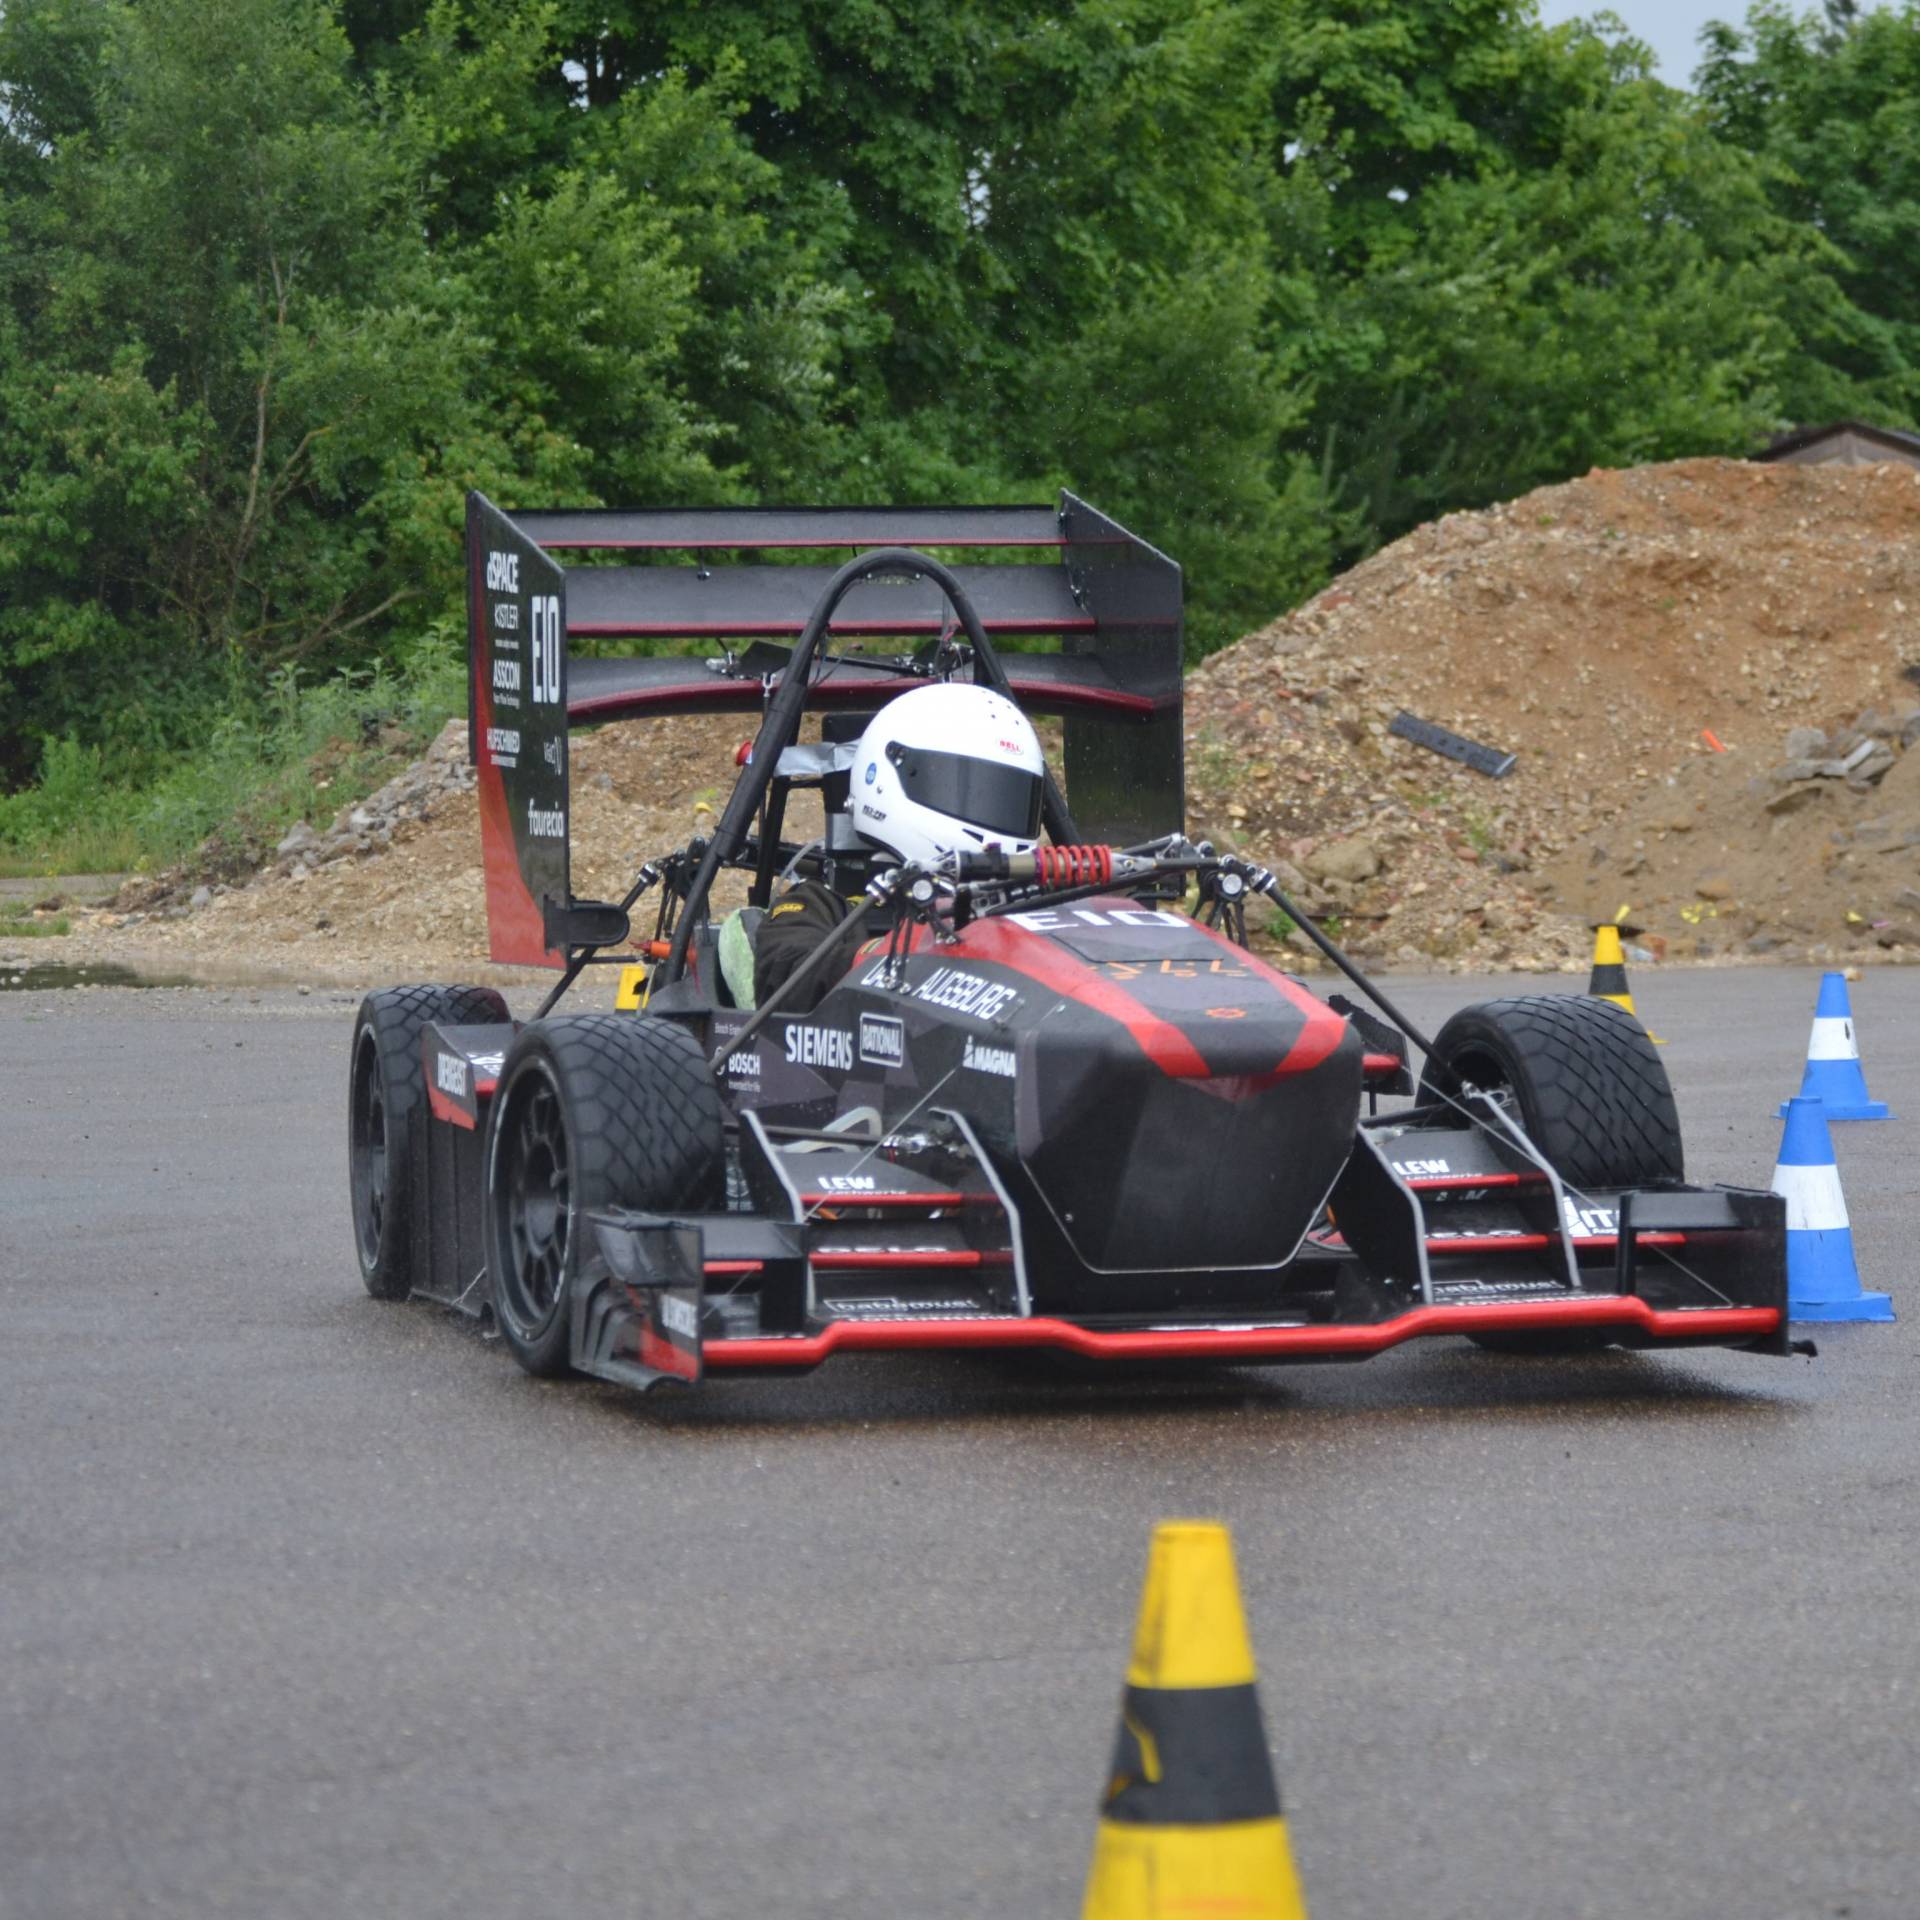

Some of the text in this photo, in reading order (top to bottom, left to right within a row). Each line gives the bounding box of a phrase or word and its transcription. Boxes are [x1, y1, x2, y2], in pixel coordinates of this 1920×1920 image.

[487, 551, 519, 594] dSPACE
[493, 659, 520, 690] ASSCON
[528, 798, 564, 837] faurecia
[912, 967, 1017, 1020] AUGSBURG
[728, 1052, 760, 1075] BOSCH
[786, 1024, 852, 1070] SIEMENS
[818, 1176, 875, 1190] LEW
[1392, 1159, 1449, 1175] LEW
